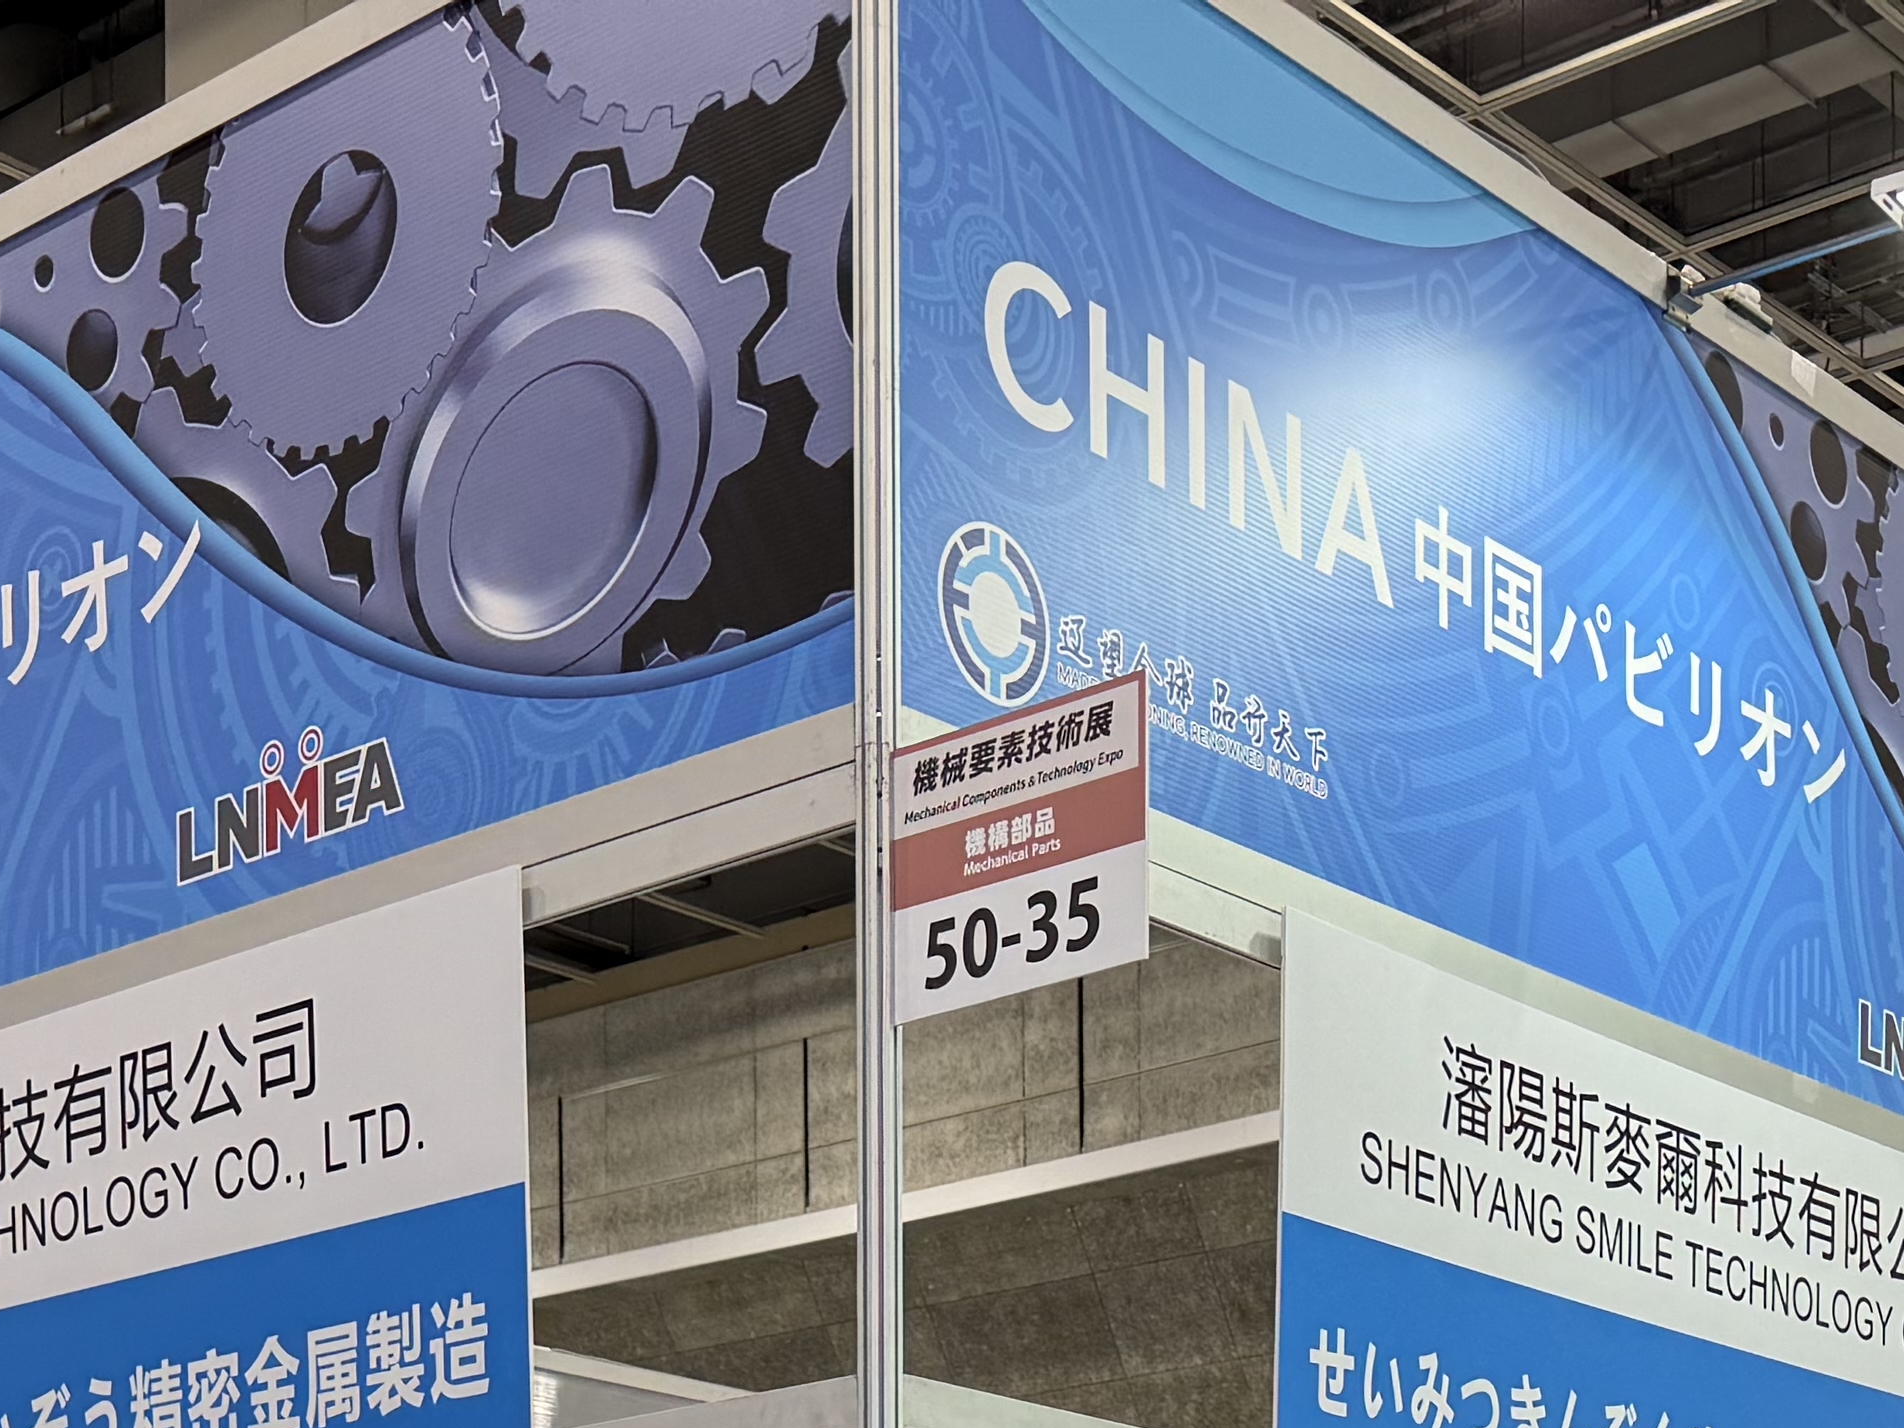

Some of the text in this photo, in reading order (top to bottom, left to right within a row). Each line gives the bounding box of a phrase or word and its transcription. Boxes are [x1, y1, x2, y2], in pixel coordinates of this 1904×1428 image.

[984, 259, 1393, 608] CHINA
[1414, 507, 1846, 804] 中国パビリオン
[904, 795, 960, 826] Mechanical
[962, 777, 1025, 808] Components
[1037, 757, 1096, 785] Technology
[1097, 748, 1124, 767] Expo
[913, 700, 1114, 796] 機械要素技術展
[1190, 724, 1263, 770] RENOWNED
[1267, 758, 1280, 778] IN
[1284, 766, 1328, 799] WORLD
[963, 838, 1062, 878] Mechanical Parts
[964, 807, 1056, 856] 機構部品
[925, 876, 1100, 990] 50-35
[214, 1143, 306, 1203] CO.,
[323, 1101, 424, 1175] LTD.
[1359, 1130, 1562, 1244] SHENYANG
[1576, 1208, 1673, 1283] SMILE
[1686, 1242, 1892, 1346] TECHNOLOGY
